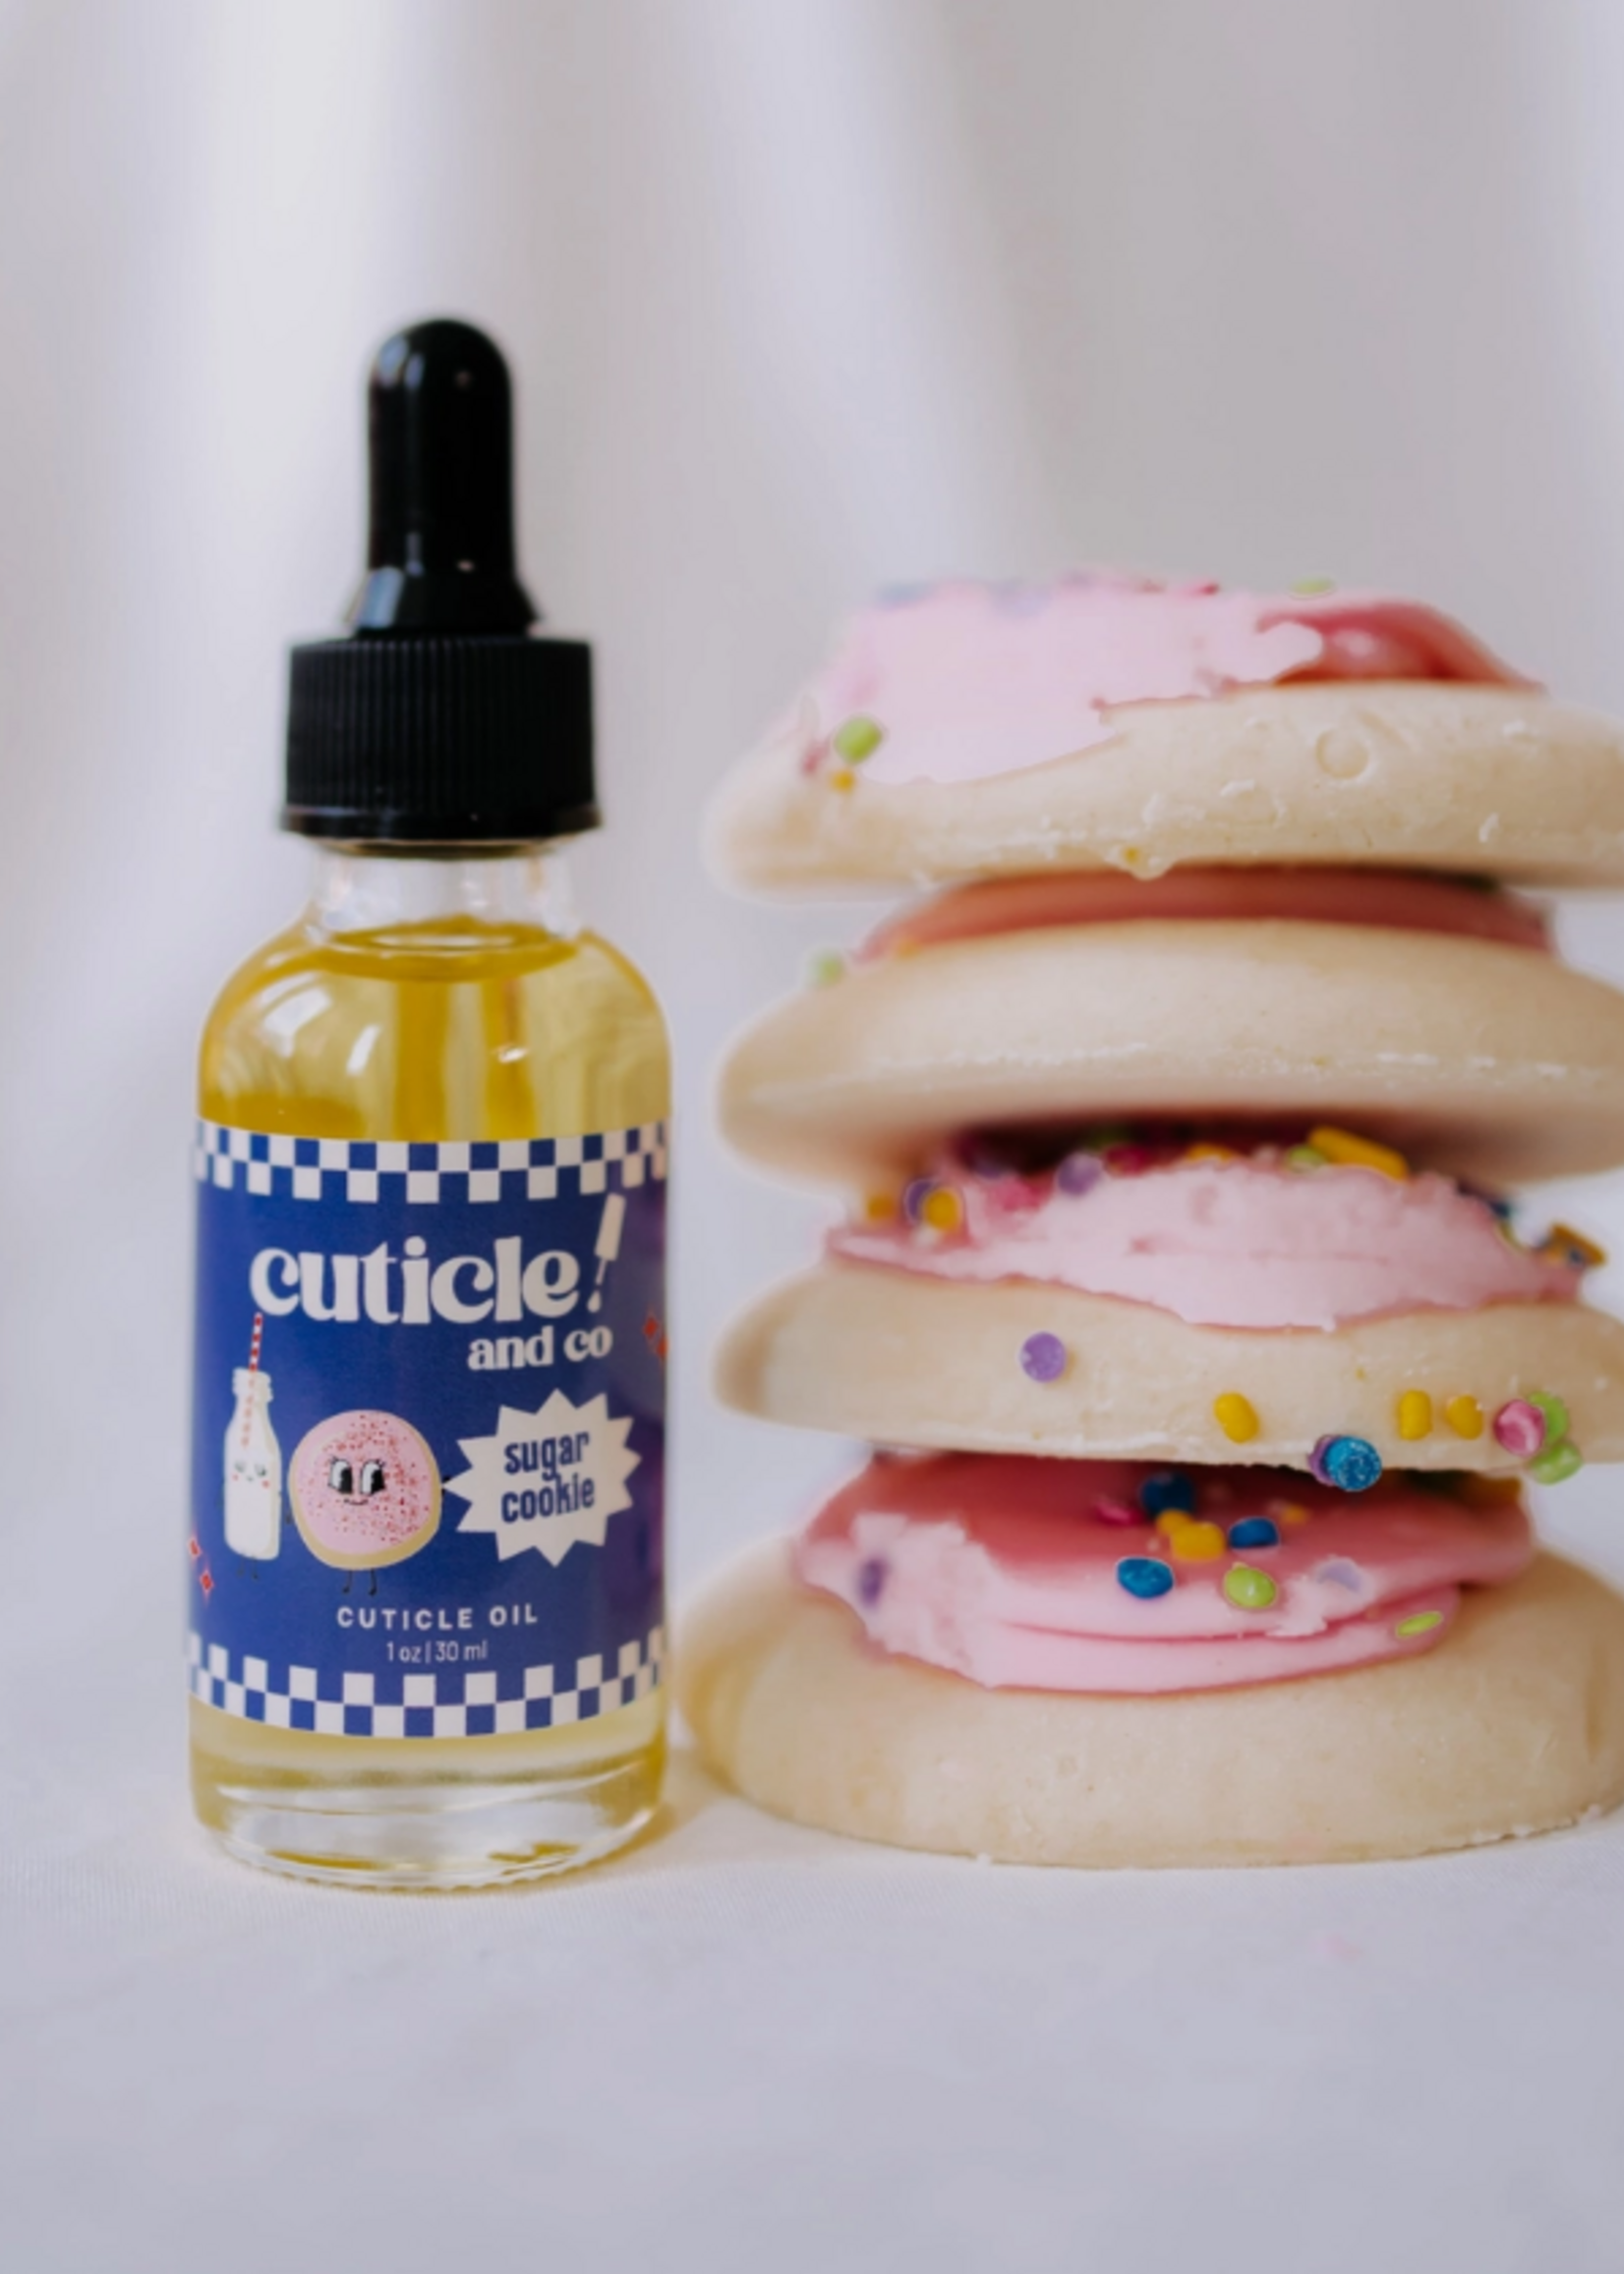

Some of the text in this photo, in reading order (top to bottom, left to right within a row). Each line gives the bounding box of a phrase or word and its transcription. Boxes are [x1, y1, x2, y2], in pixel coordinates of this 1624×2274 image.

[467, 1324, 613, 1370] and co
[504, 1430, 590, 1483] sugar
[501, 1472, 596, 1524] cookie
[337, 1603, 538, 1631] CUTICLE OIL
[386, 1640, 394, 1662] 1
[463, 1639, 488, 1662] ml
